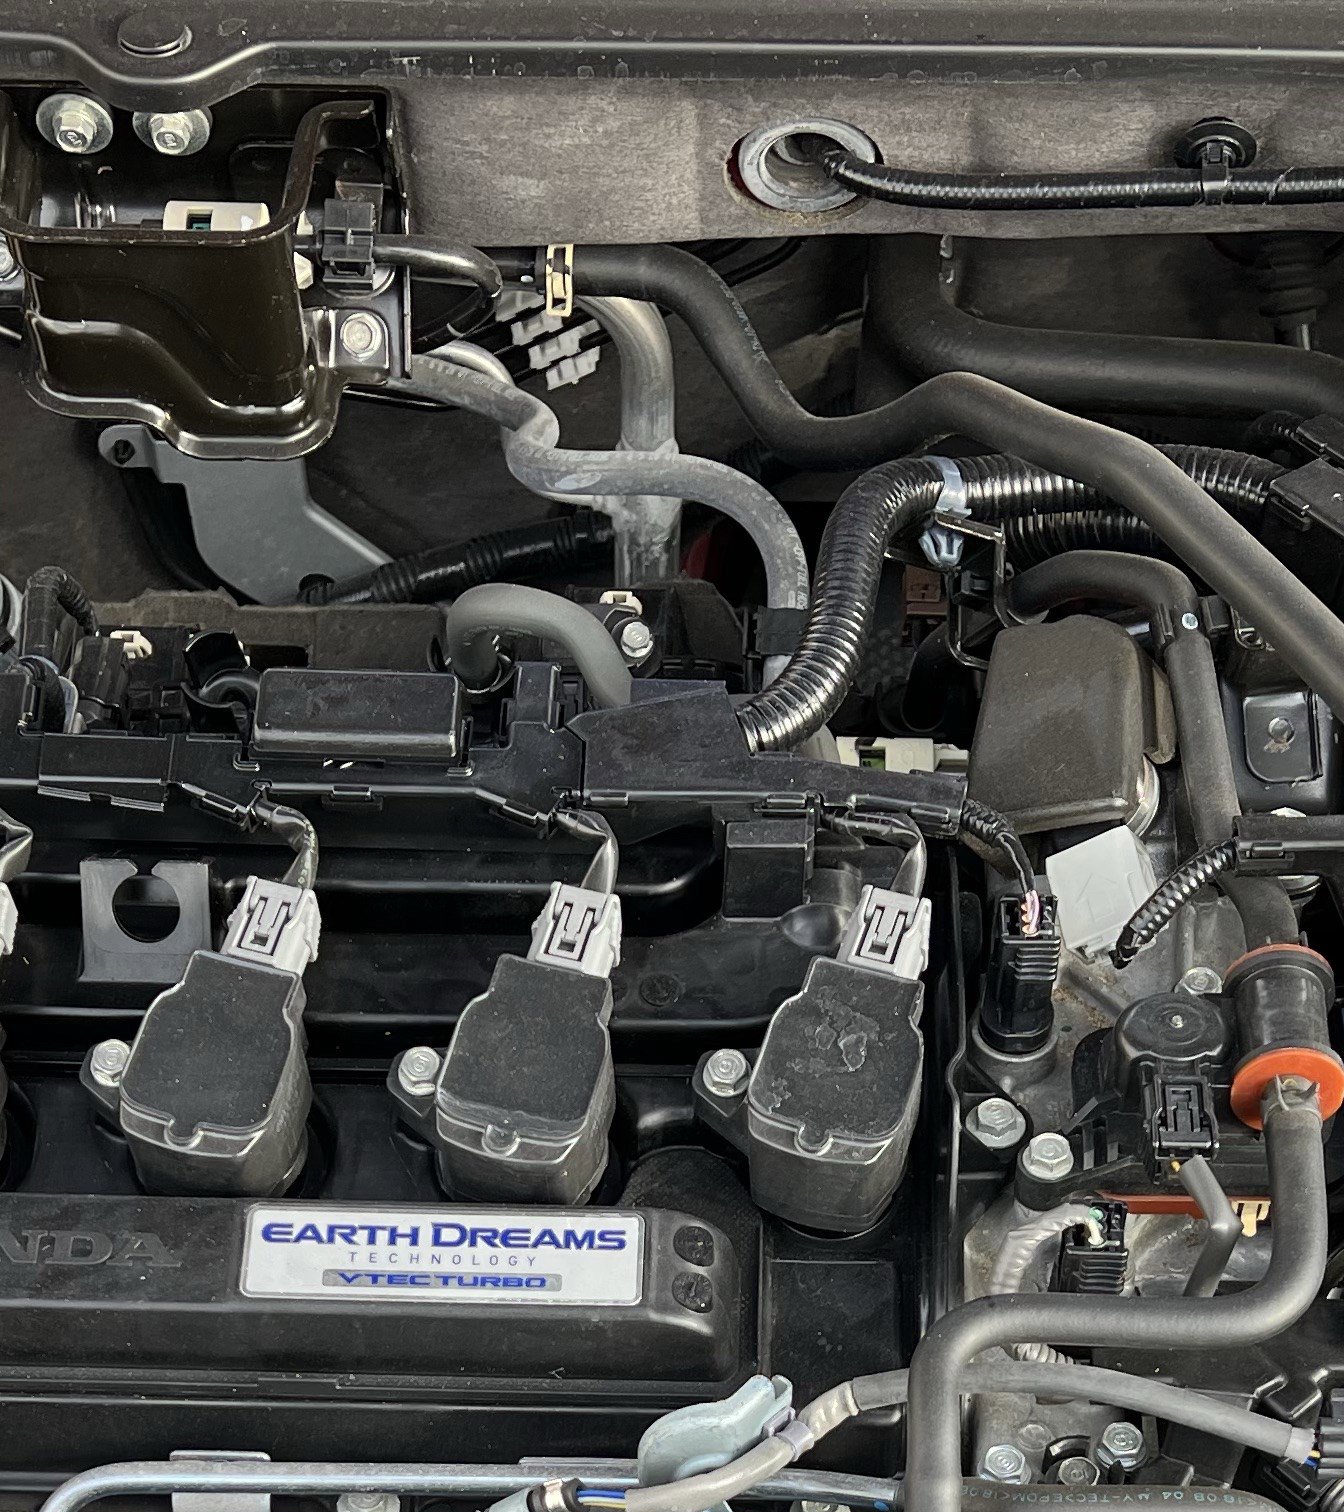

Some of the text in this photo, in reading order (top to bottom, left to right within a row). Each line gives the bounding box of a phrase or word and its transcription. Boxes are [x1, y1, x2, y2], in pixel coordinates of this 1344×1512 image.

[261, 1221, 627, 1251] EARTH DREAMS
[349, 1251, 537, 1267] TECHNOLOGY
